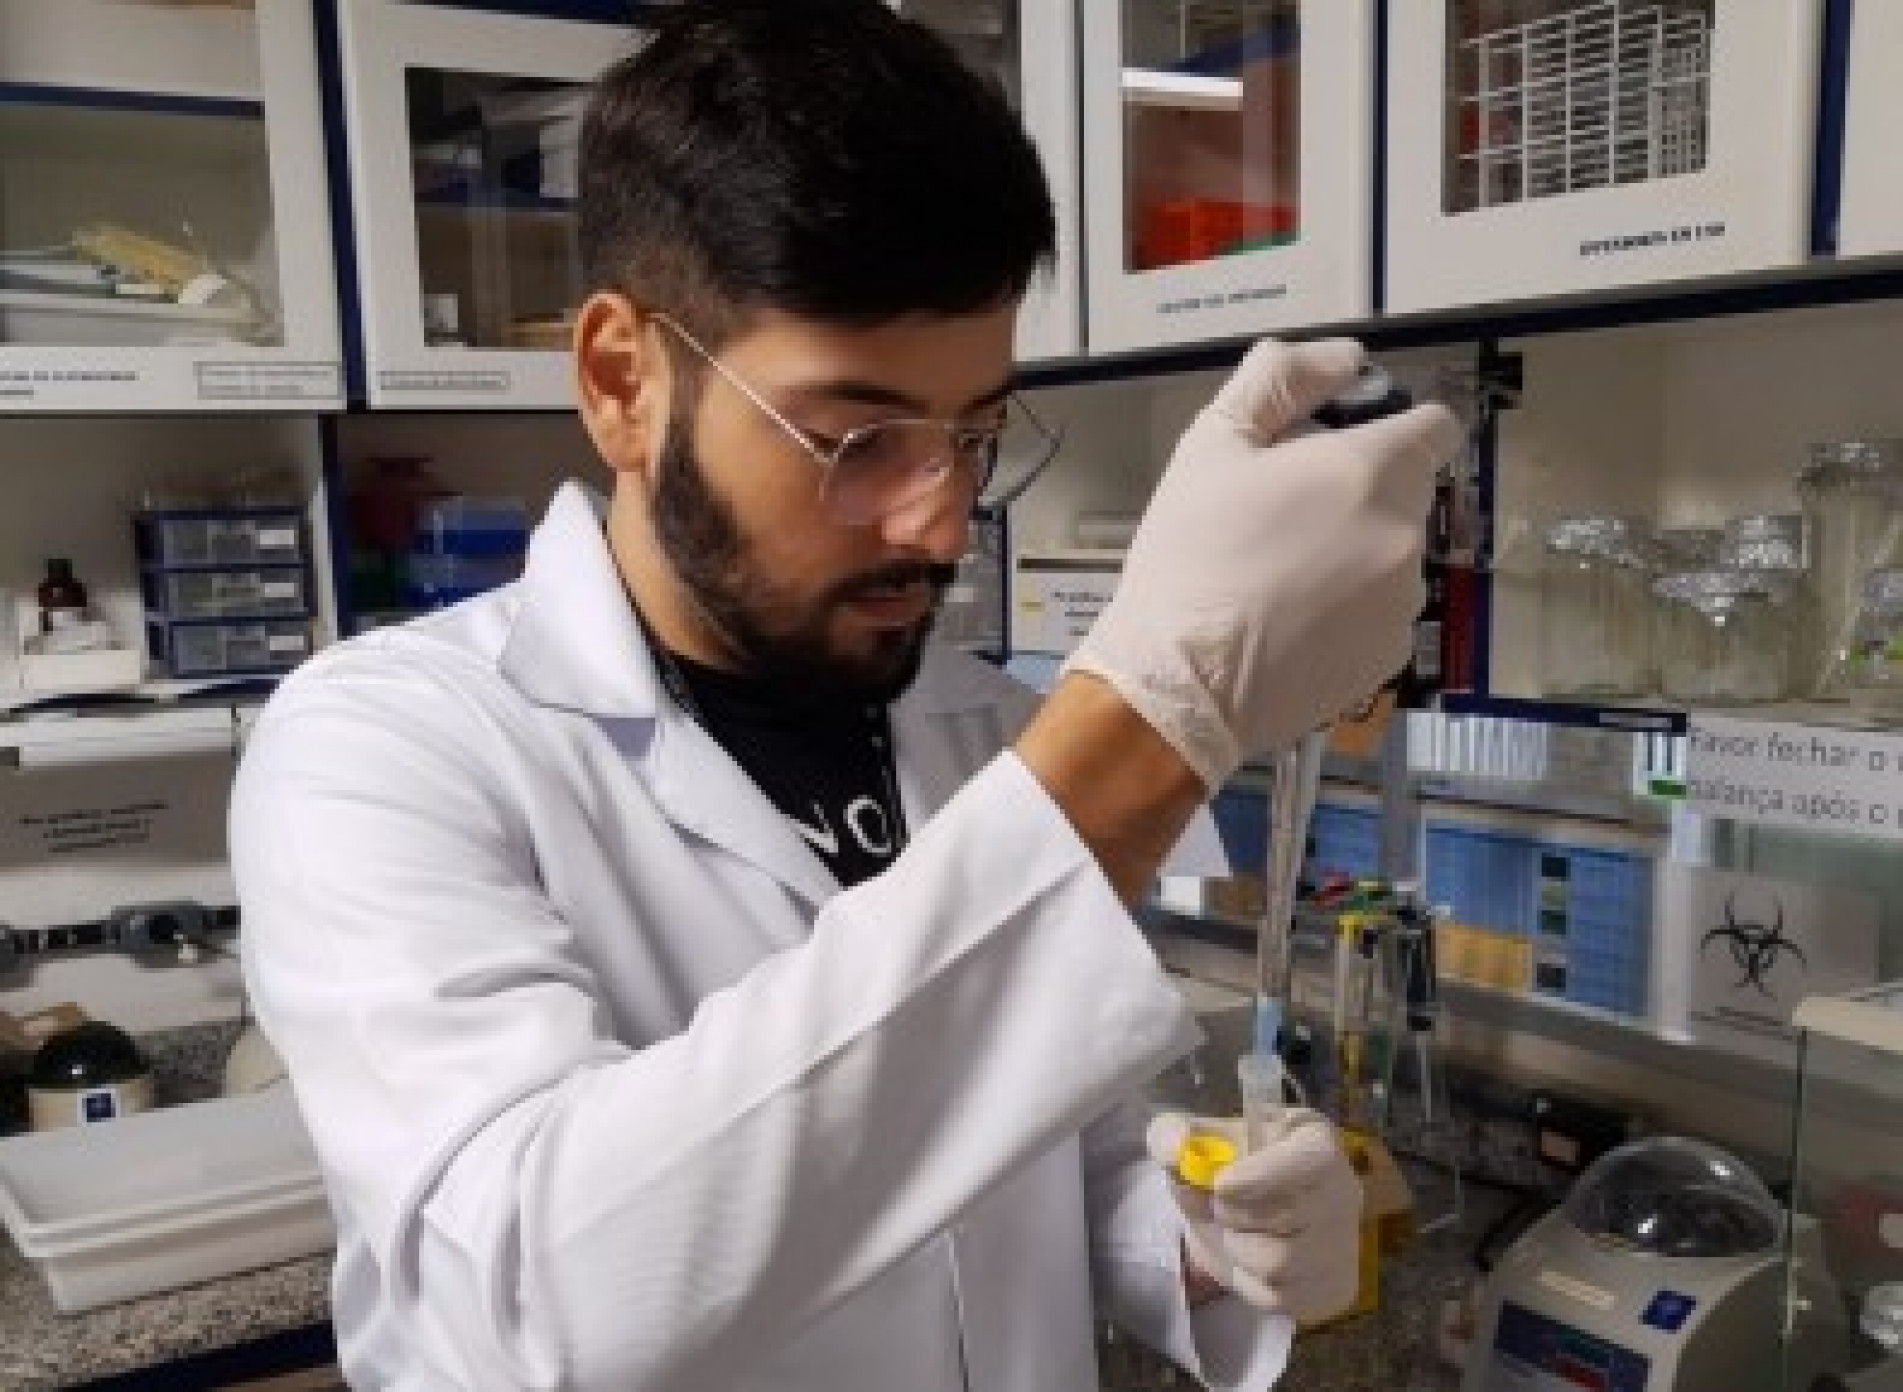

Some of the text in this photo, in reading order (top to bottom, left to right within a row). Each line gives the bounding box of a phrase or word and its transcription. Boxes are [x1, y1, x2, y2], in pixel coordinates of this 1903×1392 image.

[1767, 731, 1860, 766] fechar
[1868, 750, 1885, 772] o
[1868, 803, 1888, 825] o
